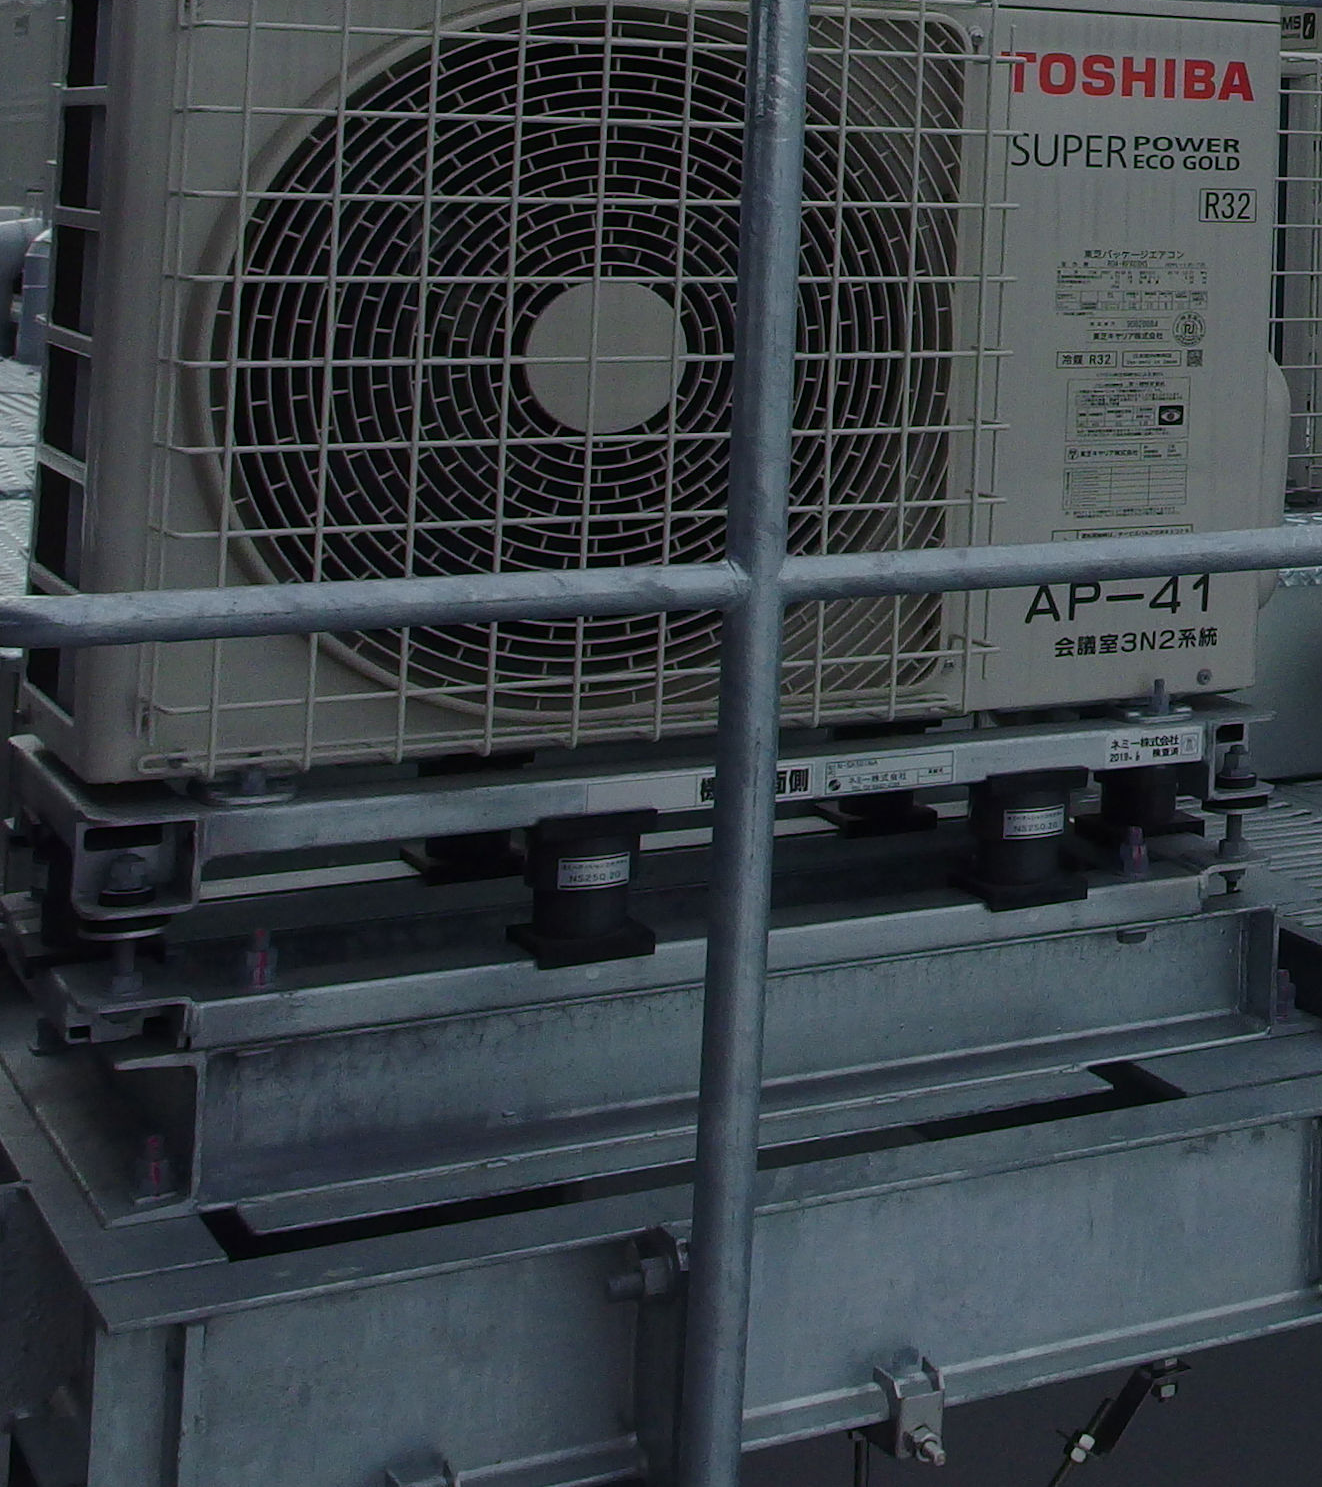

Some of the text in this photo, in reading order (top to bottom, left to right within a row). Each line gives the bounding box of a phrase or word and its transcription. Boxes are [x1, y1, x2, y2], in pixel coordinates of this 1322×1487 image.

[1002, 51, 1254, 101] TOSHIBA
[1010, 133, 1127, 169] SUPER
[1133, 136, 1240, 154] POWER
[1133, 154, 1240, 171] ECO GOLD
[1205, 192, 1251, 220] R32
[1089, 354, 1111, 366] R32
[1025, 574, 1212, 624] AP-41
[1054, 628, 1219, 658] 会議室3N2系統
[1111, 734, 1180, 750] ネミー株式会社
